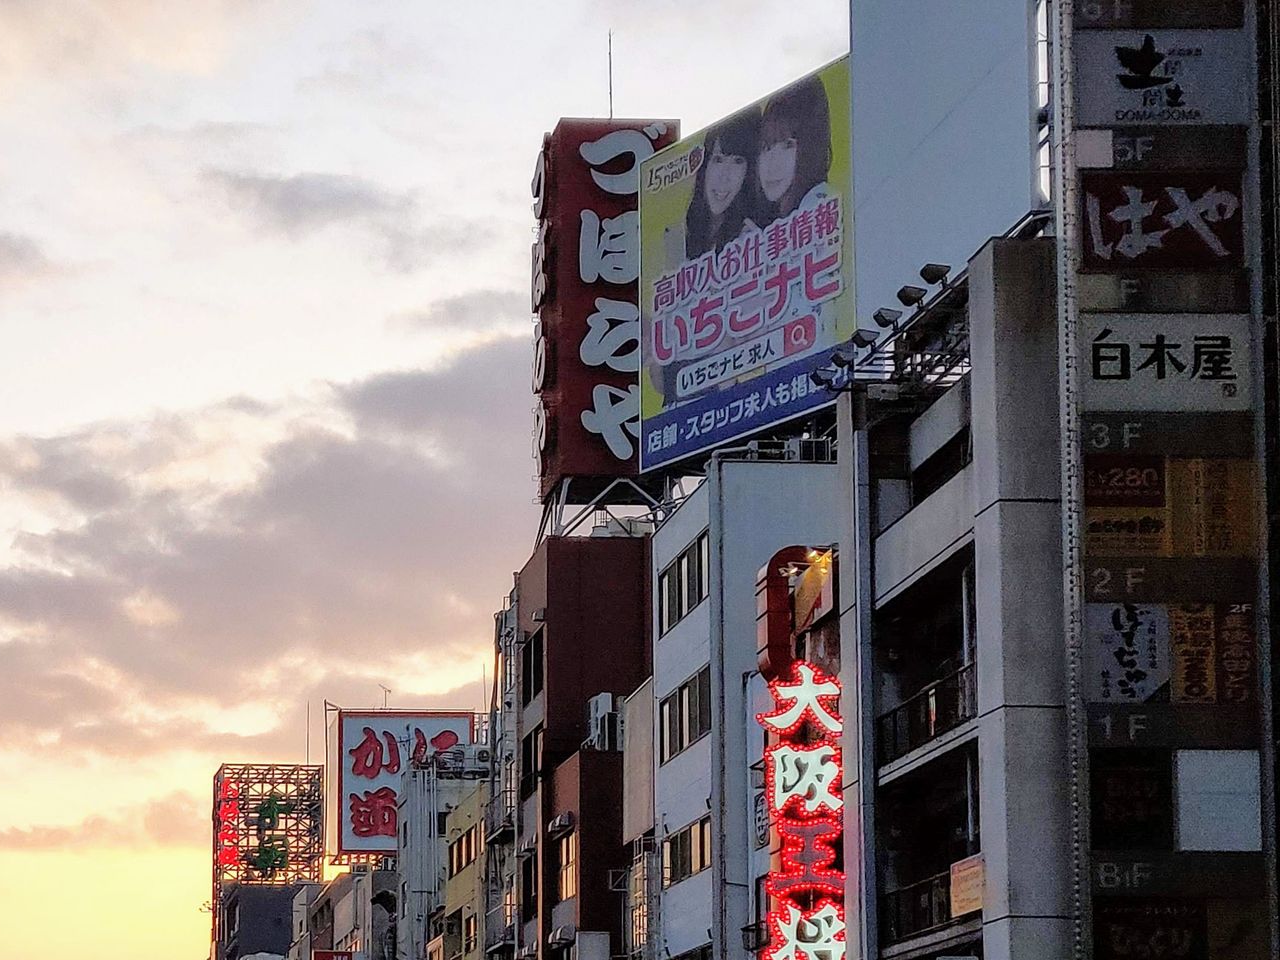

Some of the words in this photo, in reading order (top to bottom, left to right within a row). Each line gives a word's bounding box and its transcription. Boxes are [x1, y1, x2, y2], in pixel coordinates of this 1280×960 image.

[653, 198, 840, 313] 高収入お仕事情報
[653, 250, 841, 363] いちごナビ
[681, 349, 745, 391] いちごナビ
[748, 339, 775, 364] 求人
[1091, 329, 1238, 381] 白木屋
[1090, 423, 1142, 449] 3F
[1092, 567, 1145, 594] 2F
